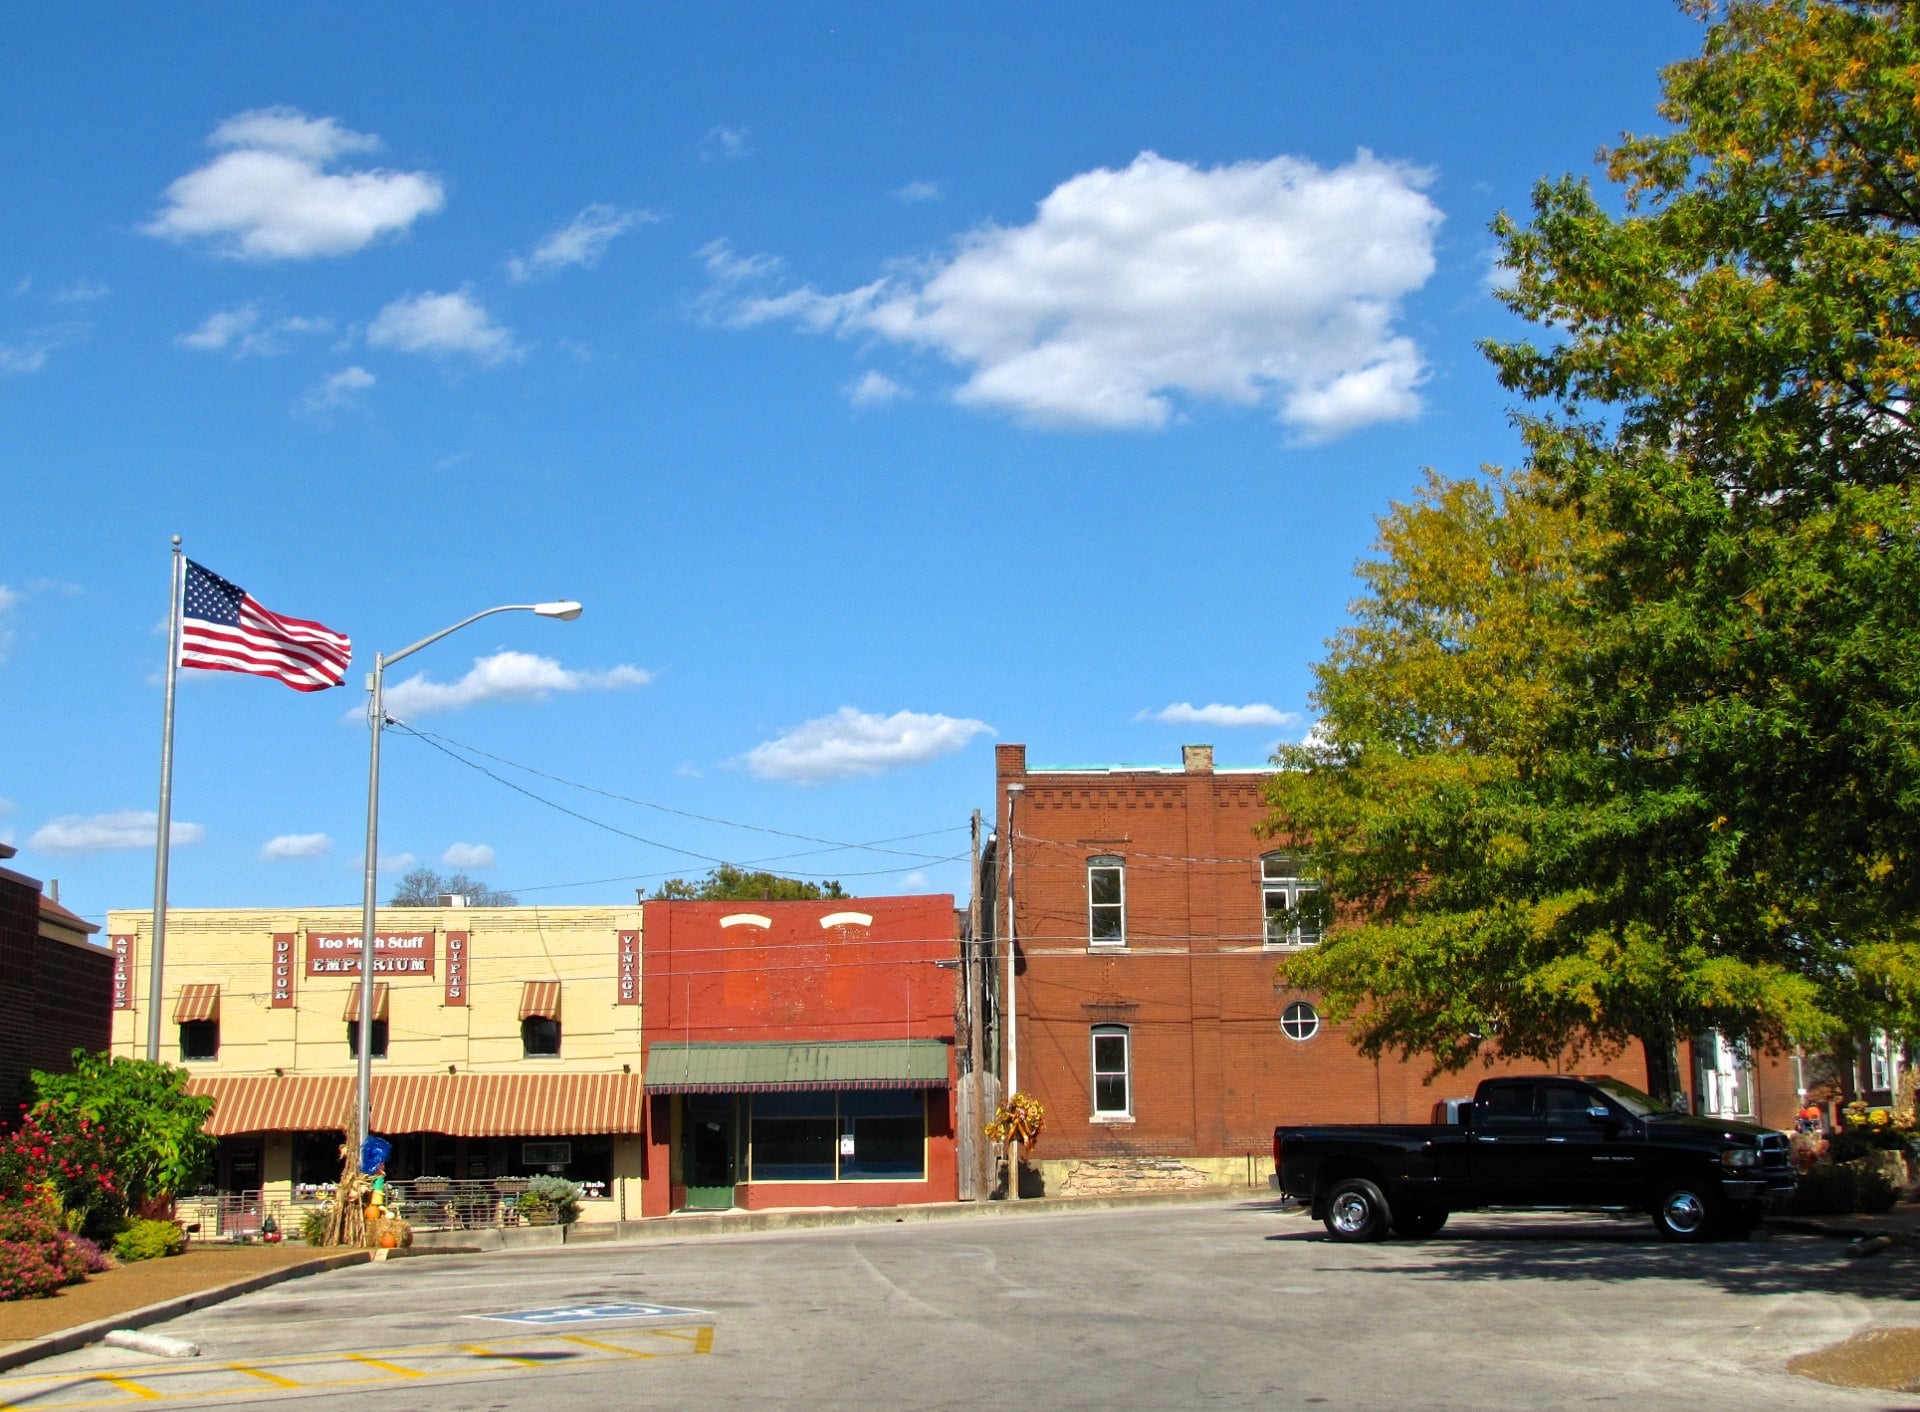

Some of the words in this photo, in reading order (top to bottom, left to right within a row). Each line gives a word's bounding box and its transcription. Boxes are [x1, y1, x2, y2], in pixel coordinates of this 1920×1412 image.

[275, 941, 290, 1000] DECOR
[317, 937, 343, 949] Too
[346, 936, 385, 949] Mh
[387, 936, 425, 949] Stuff
[449, 939, 462, 998] GIFTS
[622, 935, 634, 999] VINTAGE
[114, 938, 128, 1008] ANTIQUES
